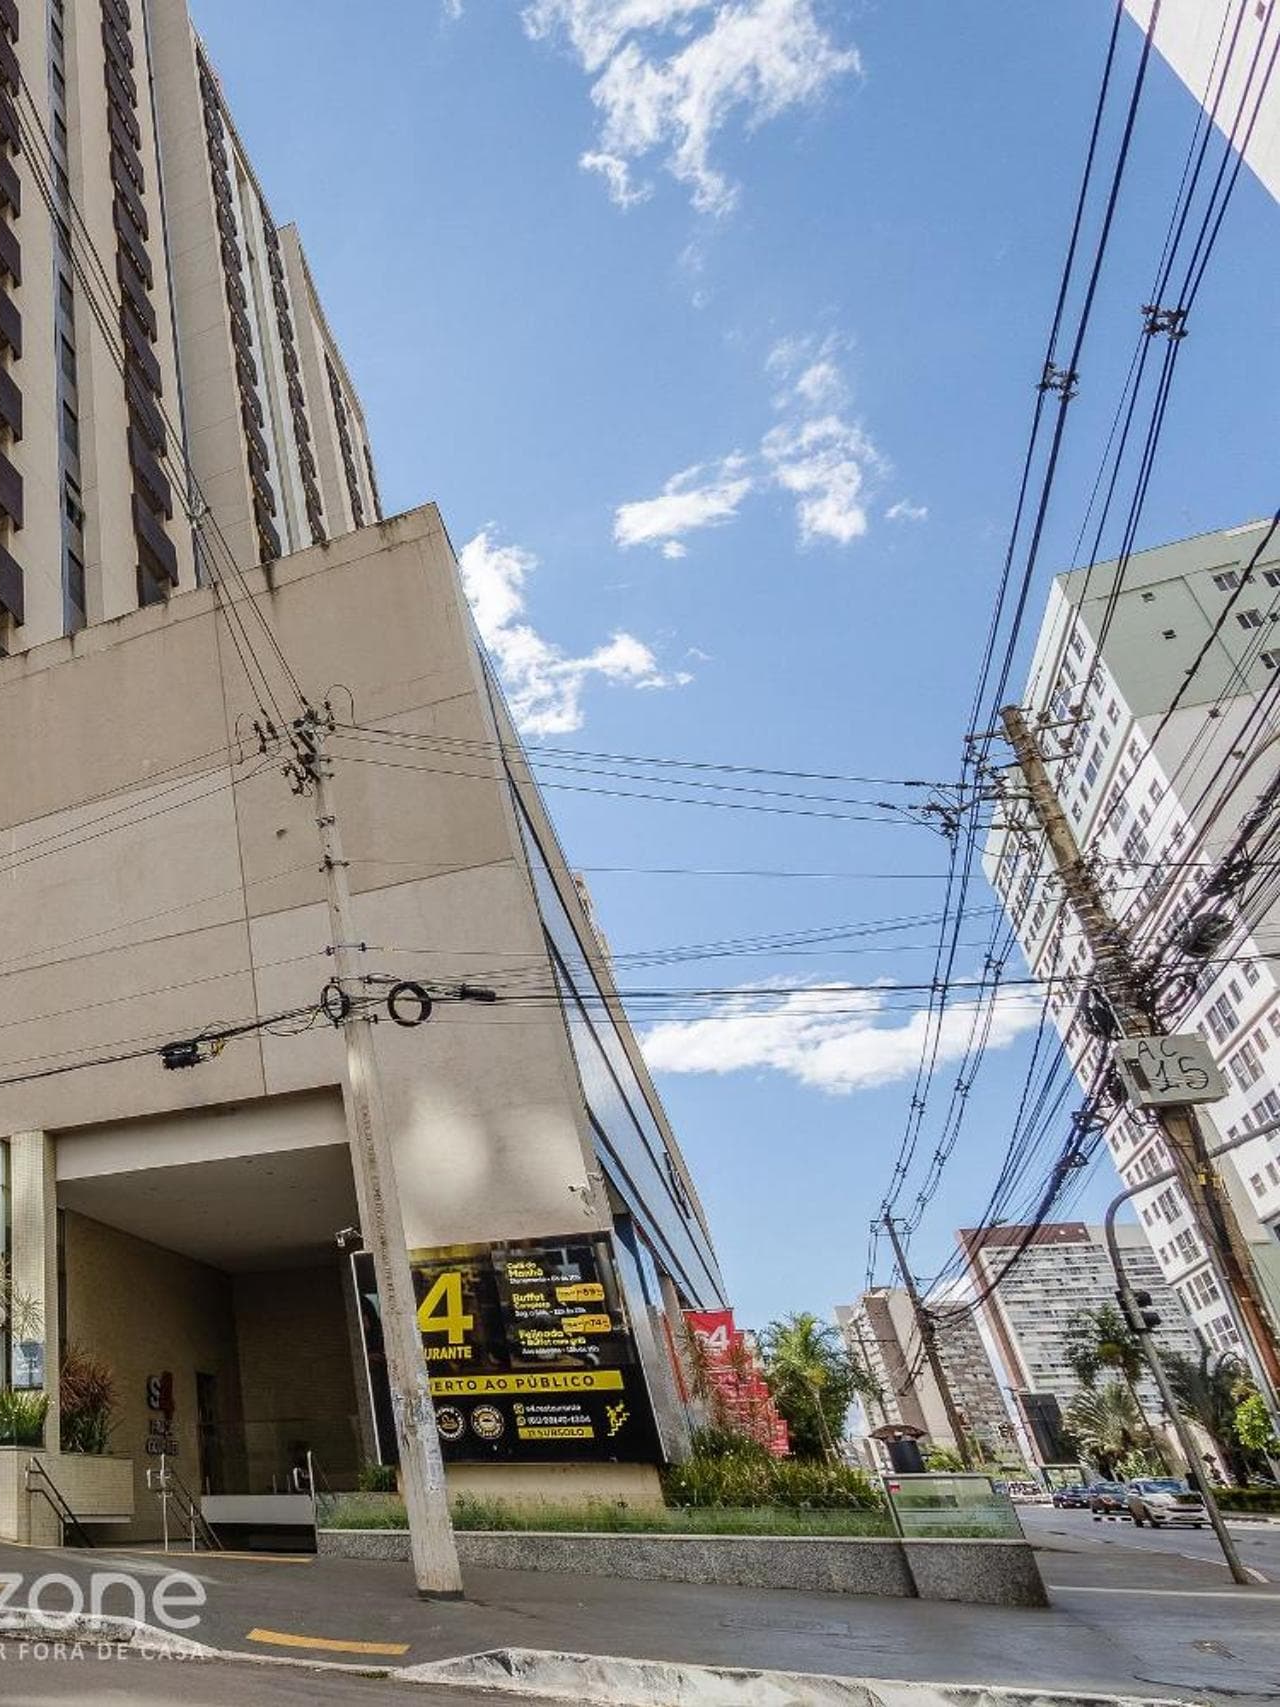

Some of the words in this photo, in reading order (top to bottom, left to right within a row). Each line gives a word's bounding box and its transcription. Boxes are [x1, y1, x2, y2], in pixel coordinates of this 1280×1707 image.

[1151, 1056, 1209, 1093] 15
[417, 1272, 473, 1344] 4
[424, 1346, 472, 1361] URANTE
[429, 1379, 478, 1394] ERTO
[485, 1377, 509, 1391] AO
[515, 1374, 596, 1390] PÚBLICO
